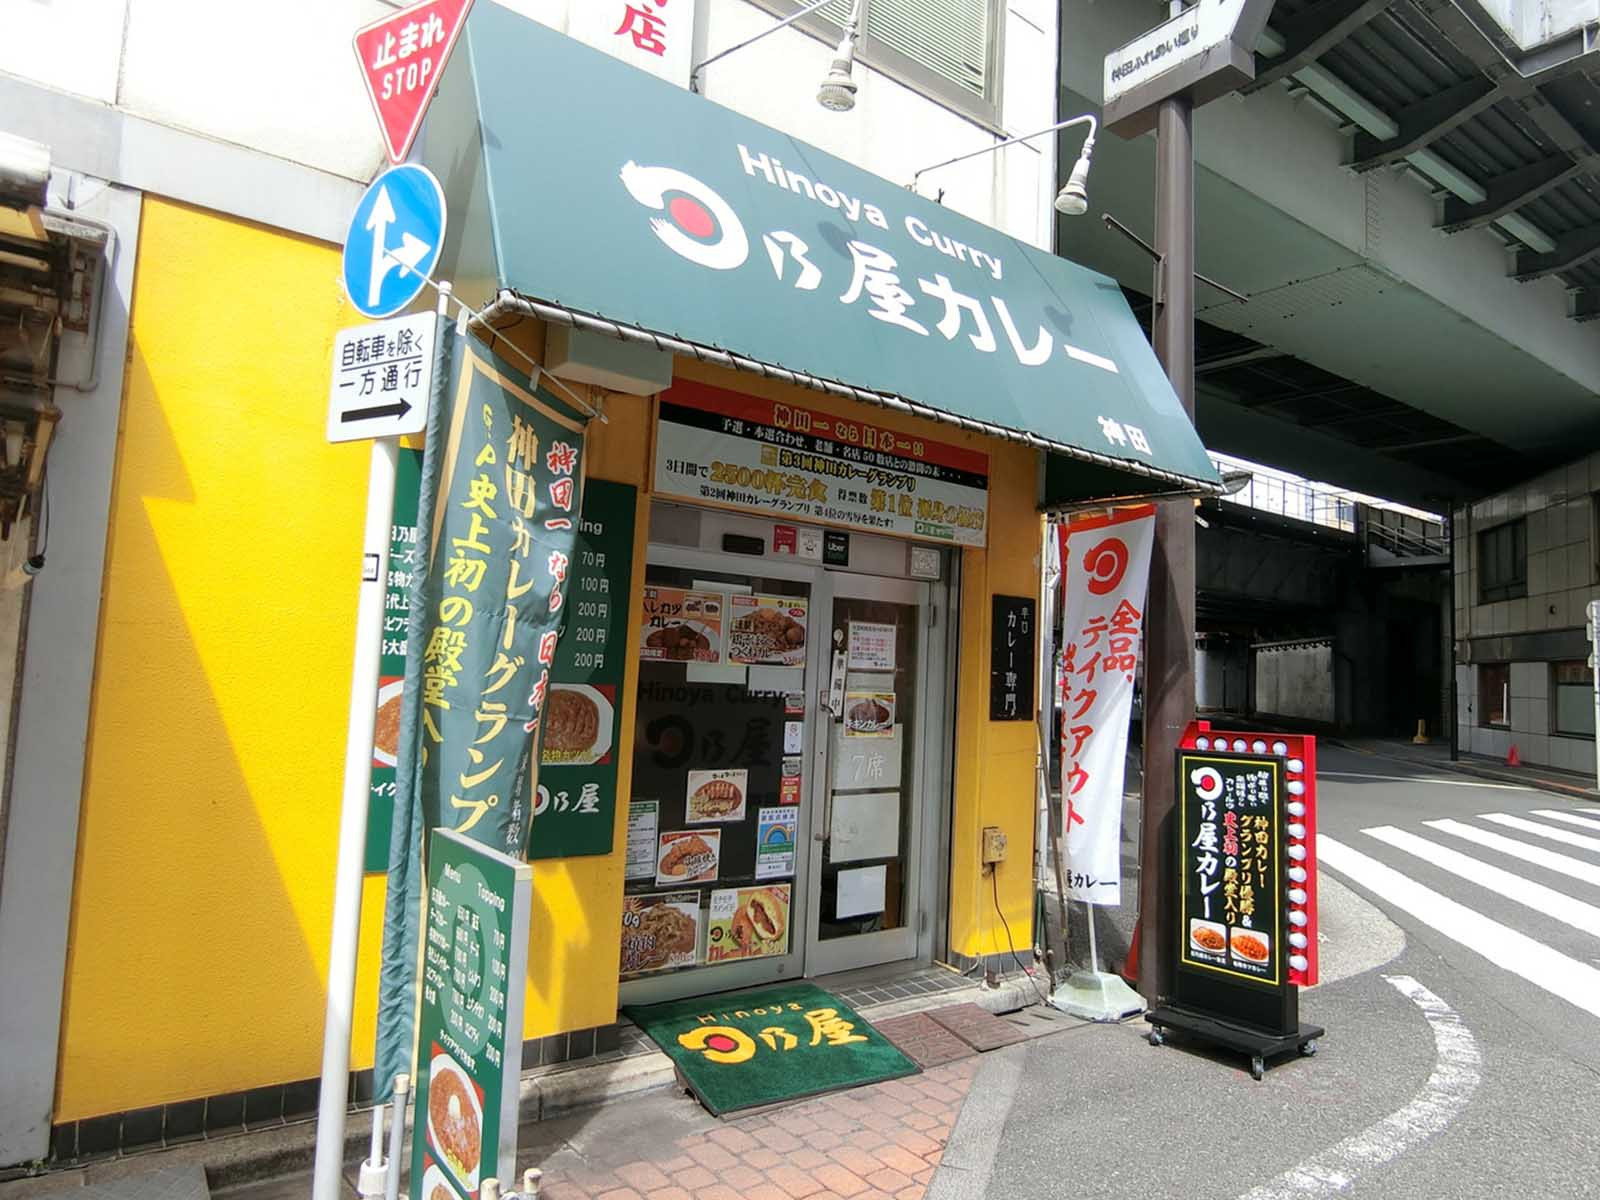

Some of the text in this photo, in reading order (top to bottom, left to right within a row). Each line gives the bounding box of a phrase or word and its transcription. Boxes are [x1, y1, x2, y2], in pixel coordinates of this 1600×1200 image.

[372, 13, 446, 70] 止まれ
[614, 0, 667, 56] 店
[381, 57, 432, 100] STOP
[737, 144, 1002, 279] Hinoya Curry
[342, 328, 423, 367] 自転車を除く
[339, 360, 422, 396] 一方通行
[1098, 415, 1152, 456] 神田
[582, 552, 605, 567] 70円
[581, 578, 609, 592] 100円
[578, 603, 607, 618] 200円
[650, 616, 680, 628] カレー
[576, 628, 606, 643] 200円
[574, 653, 604, 668] 200円
[1005, 611, 1017, 716] カレー専門
[1067, 616, 1109, 832] テイクアウト
[1254, 816, 1269, 888] 神田カレー
[478, 881, 504, 912] Topping
[624, 911, 641, 928] 0g
[697, 1001, 803, 1025] Hinoya
